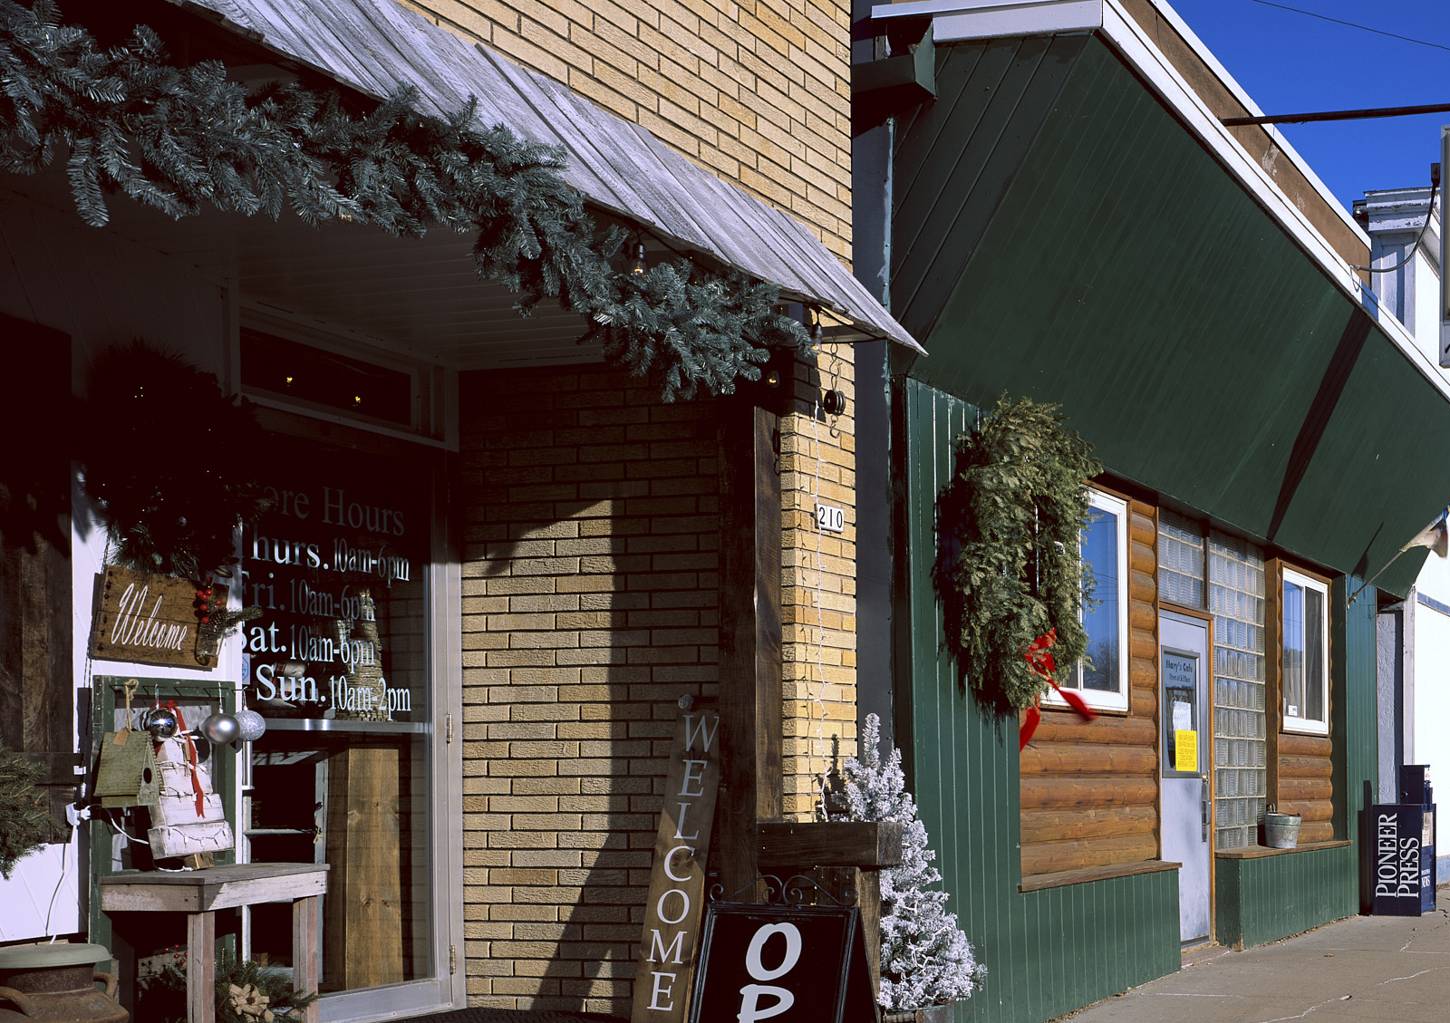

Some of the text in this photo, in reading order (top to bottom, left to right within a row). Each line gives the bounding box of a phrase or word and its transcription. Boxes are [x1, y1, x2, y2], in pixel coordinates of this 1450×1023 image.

[321, 486, 406, 537] Hours
[819, 506, 843, 529] 210
[249, 518, 411, 589] hurs. 10am-6pm
[111, 581, 189, 652] Welcome
[289, 577, 376, 629] 10am-6pm
[290, 624, 376, 675] 10am-6pm
[255, 663, 327, 703] Sun.
[329, 675, 412, 721] 10am-2pm
[646, 713, 720, 1013] WELCOME
[1375, 812, 1398, 899] PIONEER
[1397, 836, 1419, 899] PRESS
